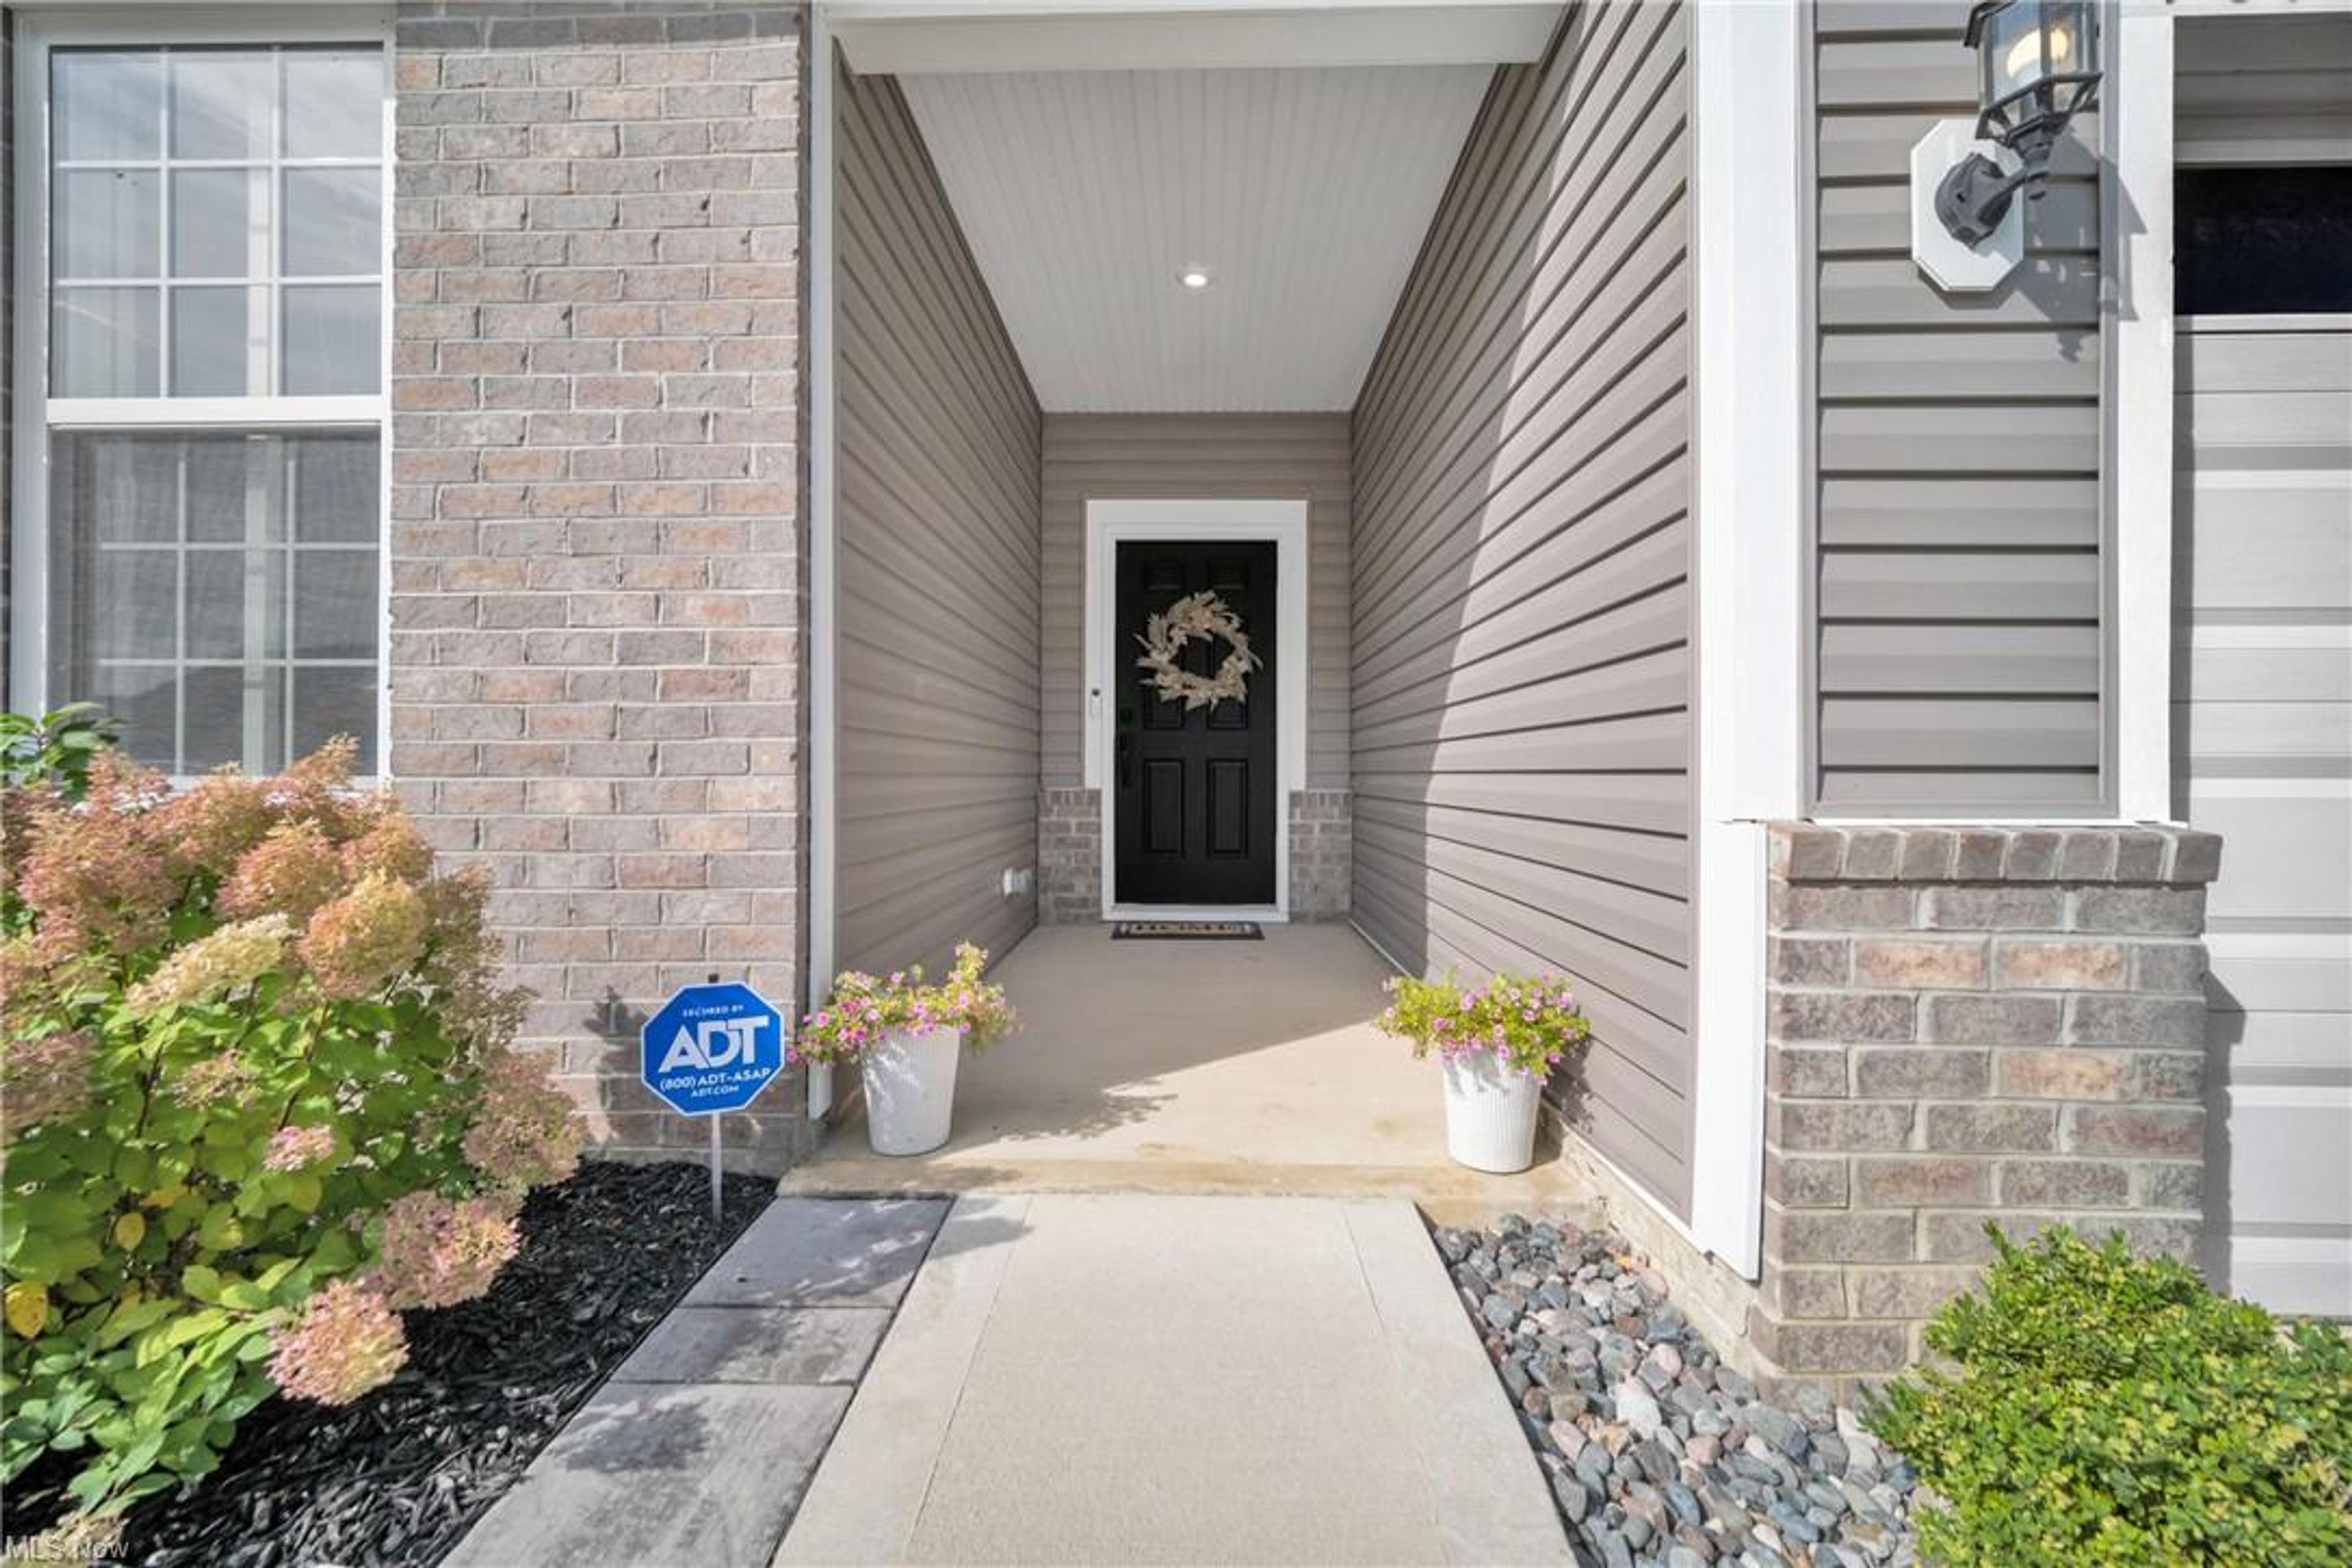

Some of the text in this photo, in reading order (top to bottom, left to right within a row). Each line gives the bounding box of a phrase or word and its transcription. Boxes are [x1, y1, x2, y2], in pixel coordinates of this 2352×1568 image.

[658, 1015, 769, 1073] ADT
[660, 1068, 771, 1092] (800) ADT-ASAP
